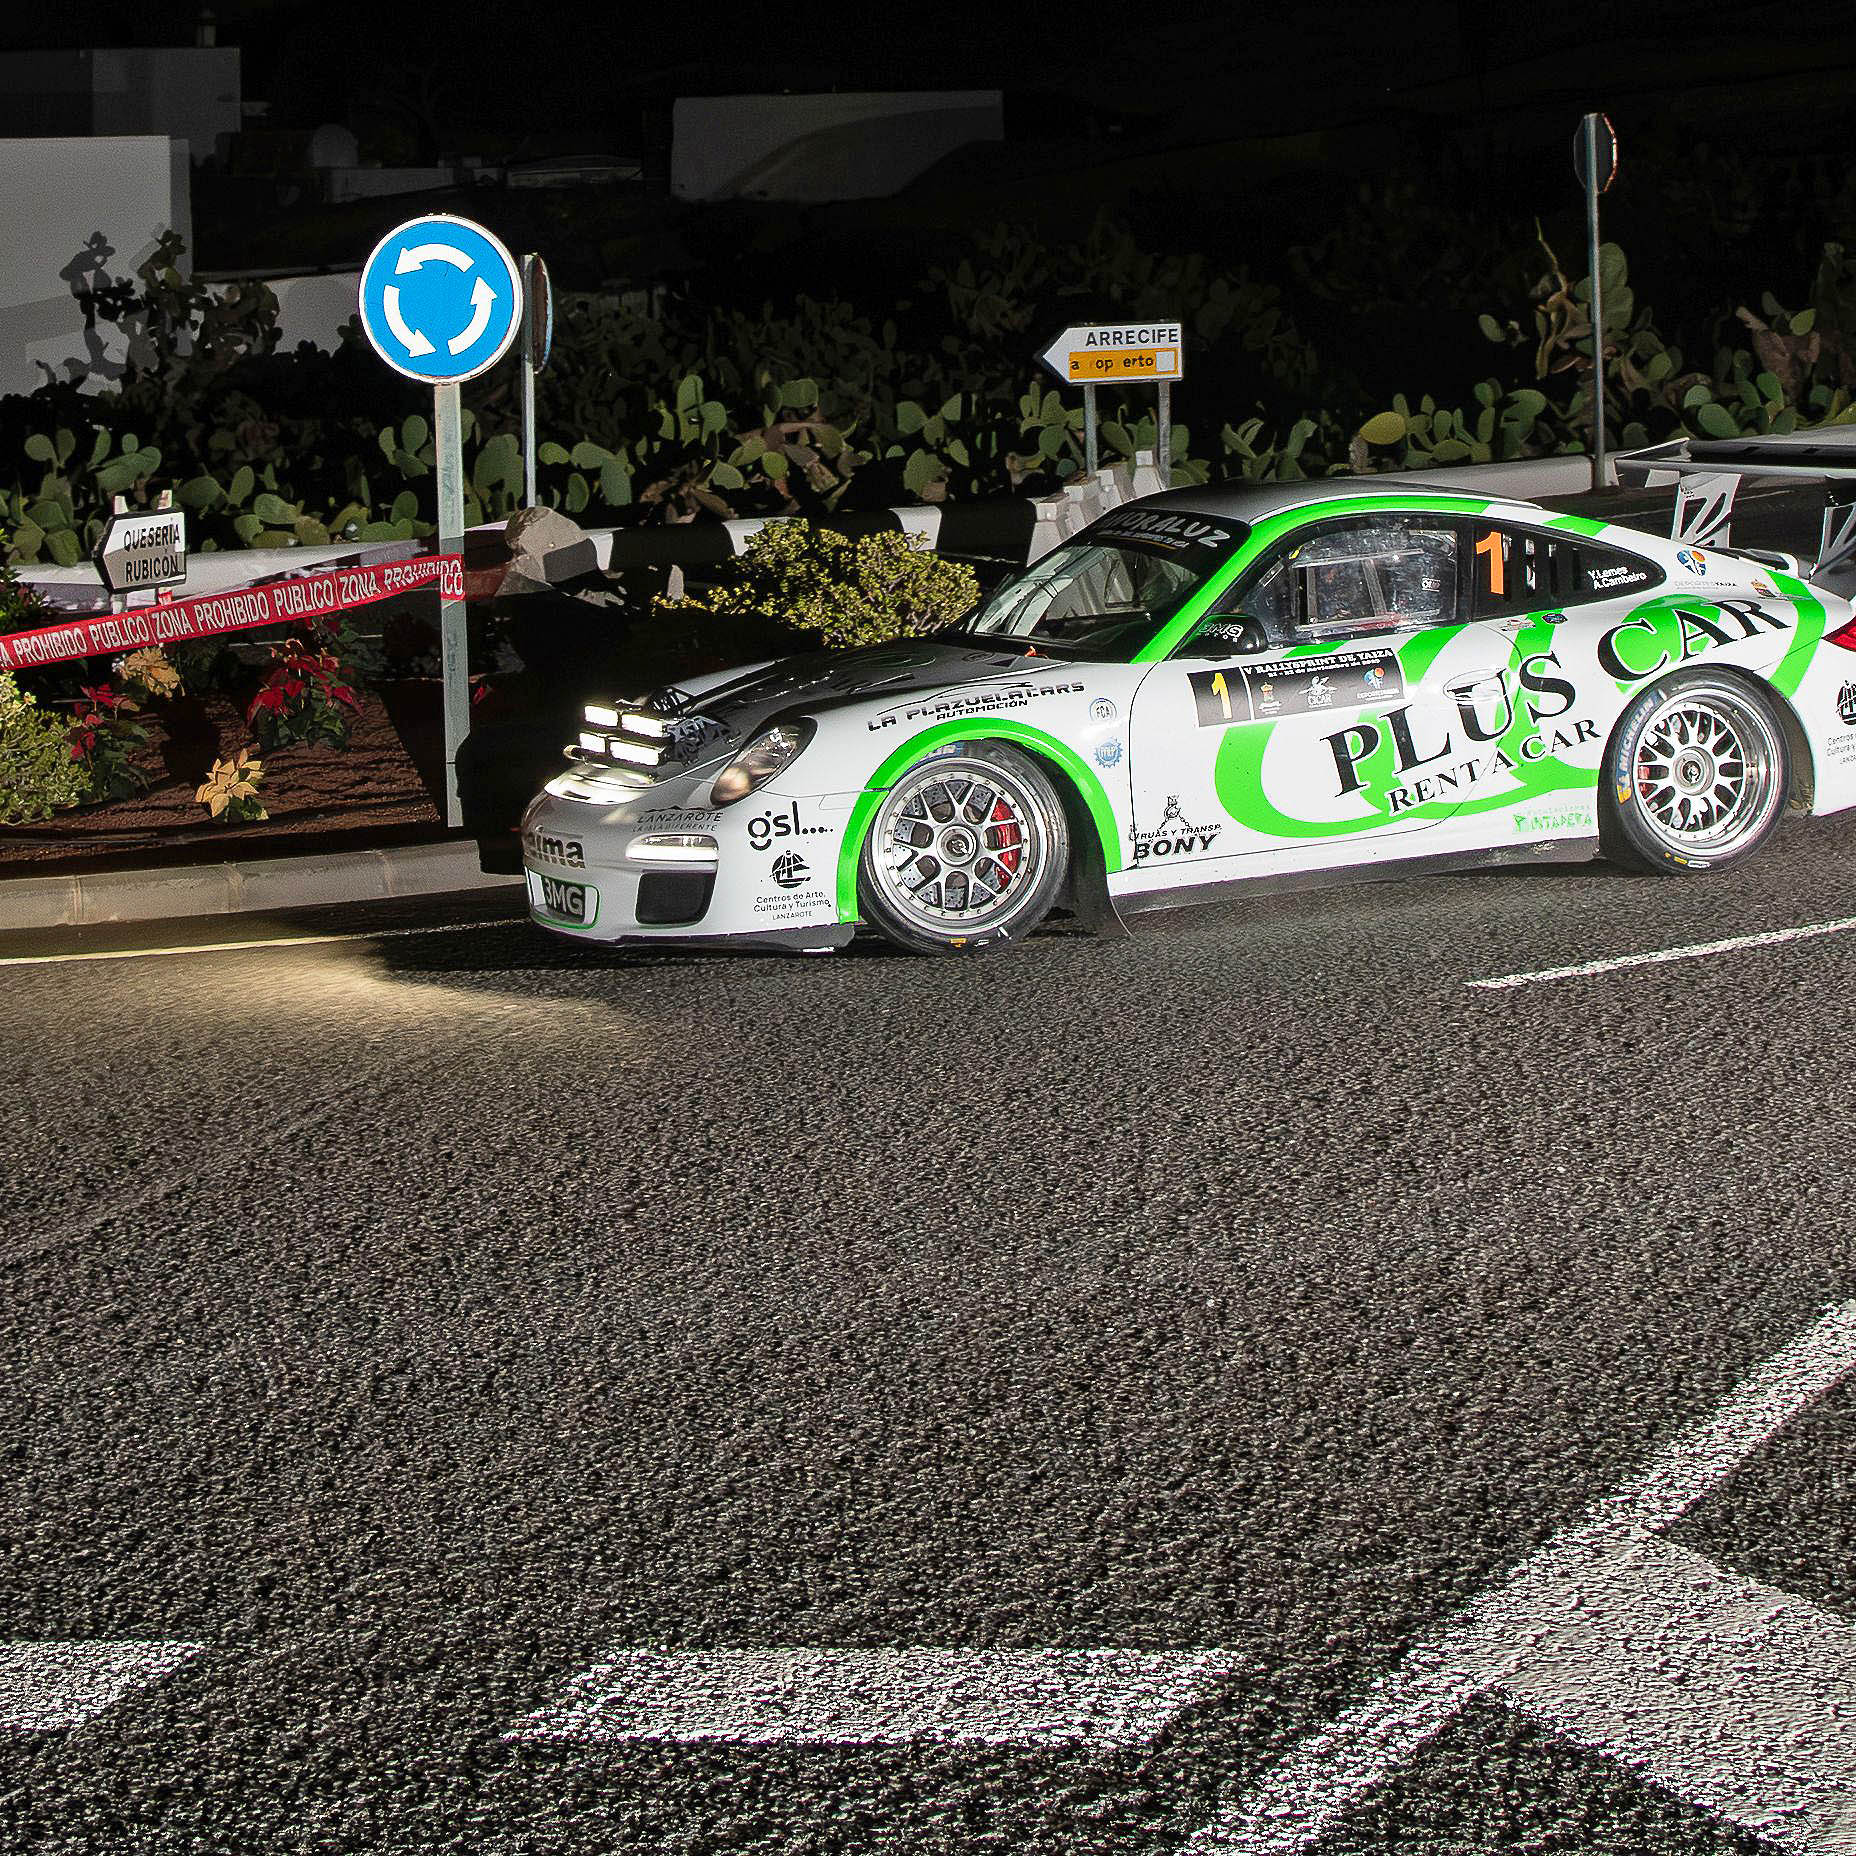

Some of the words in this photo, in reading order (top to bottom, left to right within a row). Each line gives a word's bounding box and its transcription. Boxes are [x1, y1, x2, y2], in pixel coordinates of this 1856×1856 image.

[1085, 328, 1179, 347] ARRECIFE
[125, 548, 179, 583] RUBICÓN
[1475, 531, 1505, 595] 1
[14, 628, 89, 665] PROHIBIDO
[89, 615, 150, 652] PUBLICO
[151, 608, 194, 639] ZONA
[194, 591, 270, 632] PROHIBIDO
[273, 579, 335, 617] PUBLICO
[338, 570, 382, 605] ZONA
[936, 699, 1028, 721] AUTOMOCIÓN
[1211, 672, 1233, 720] 1
[1319, 651, 1577, 798] PLUS
[1597, 598, 1792, 684] CAR
[1386, 757, 1482, 814] RENT
[1521, 718, 1601, 760] CAR
[636, 811, 724, 824] LANZAROTE
[1133, 833, 1218, 860] BONY
[753, 901, 787, 913] Cultura
[795, 898, 830, 908] Turismo
[756, 894, 792, 904] Centros
[792, 892, 804, 900] de
